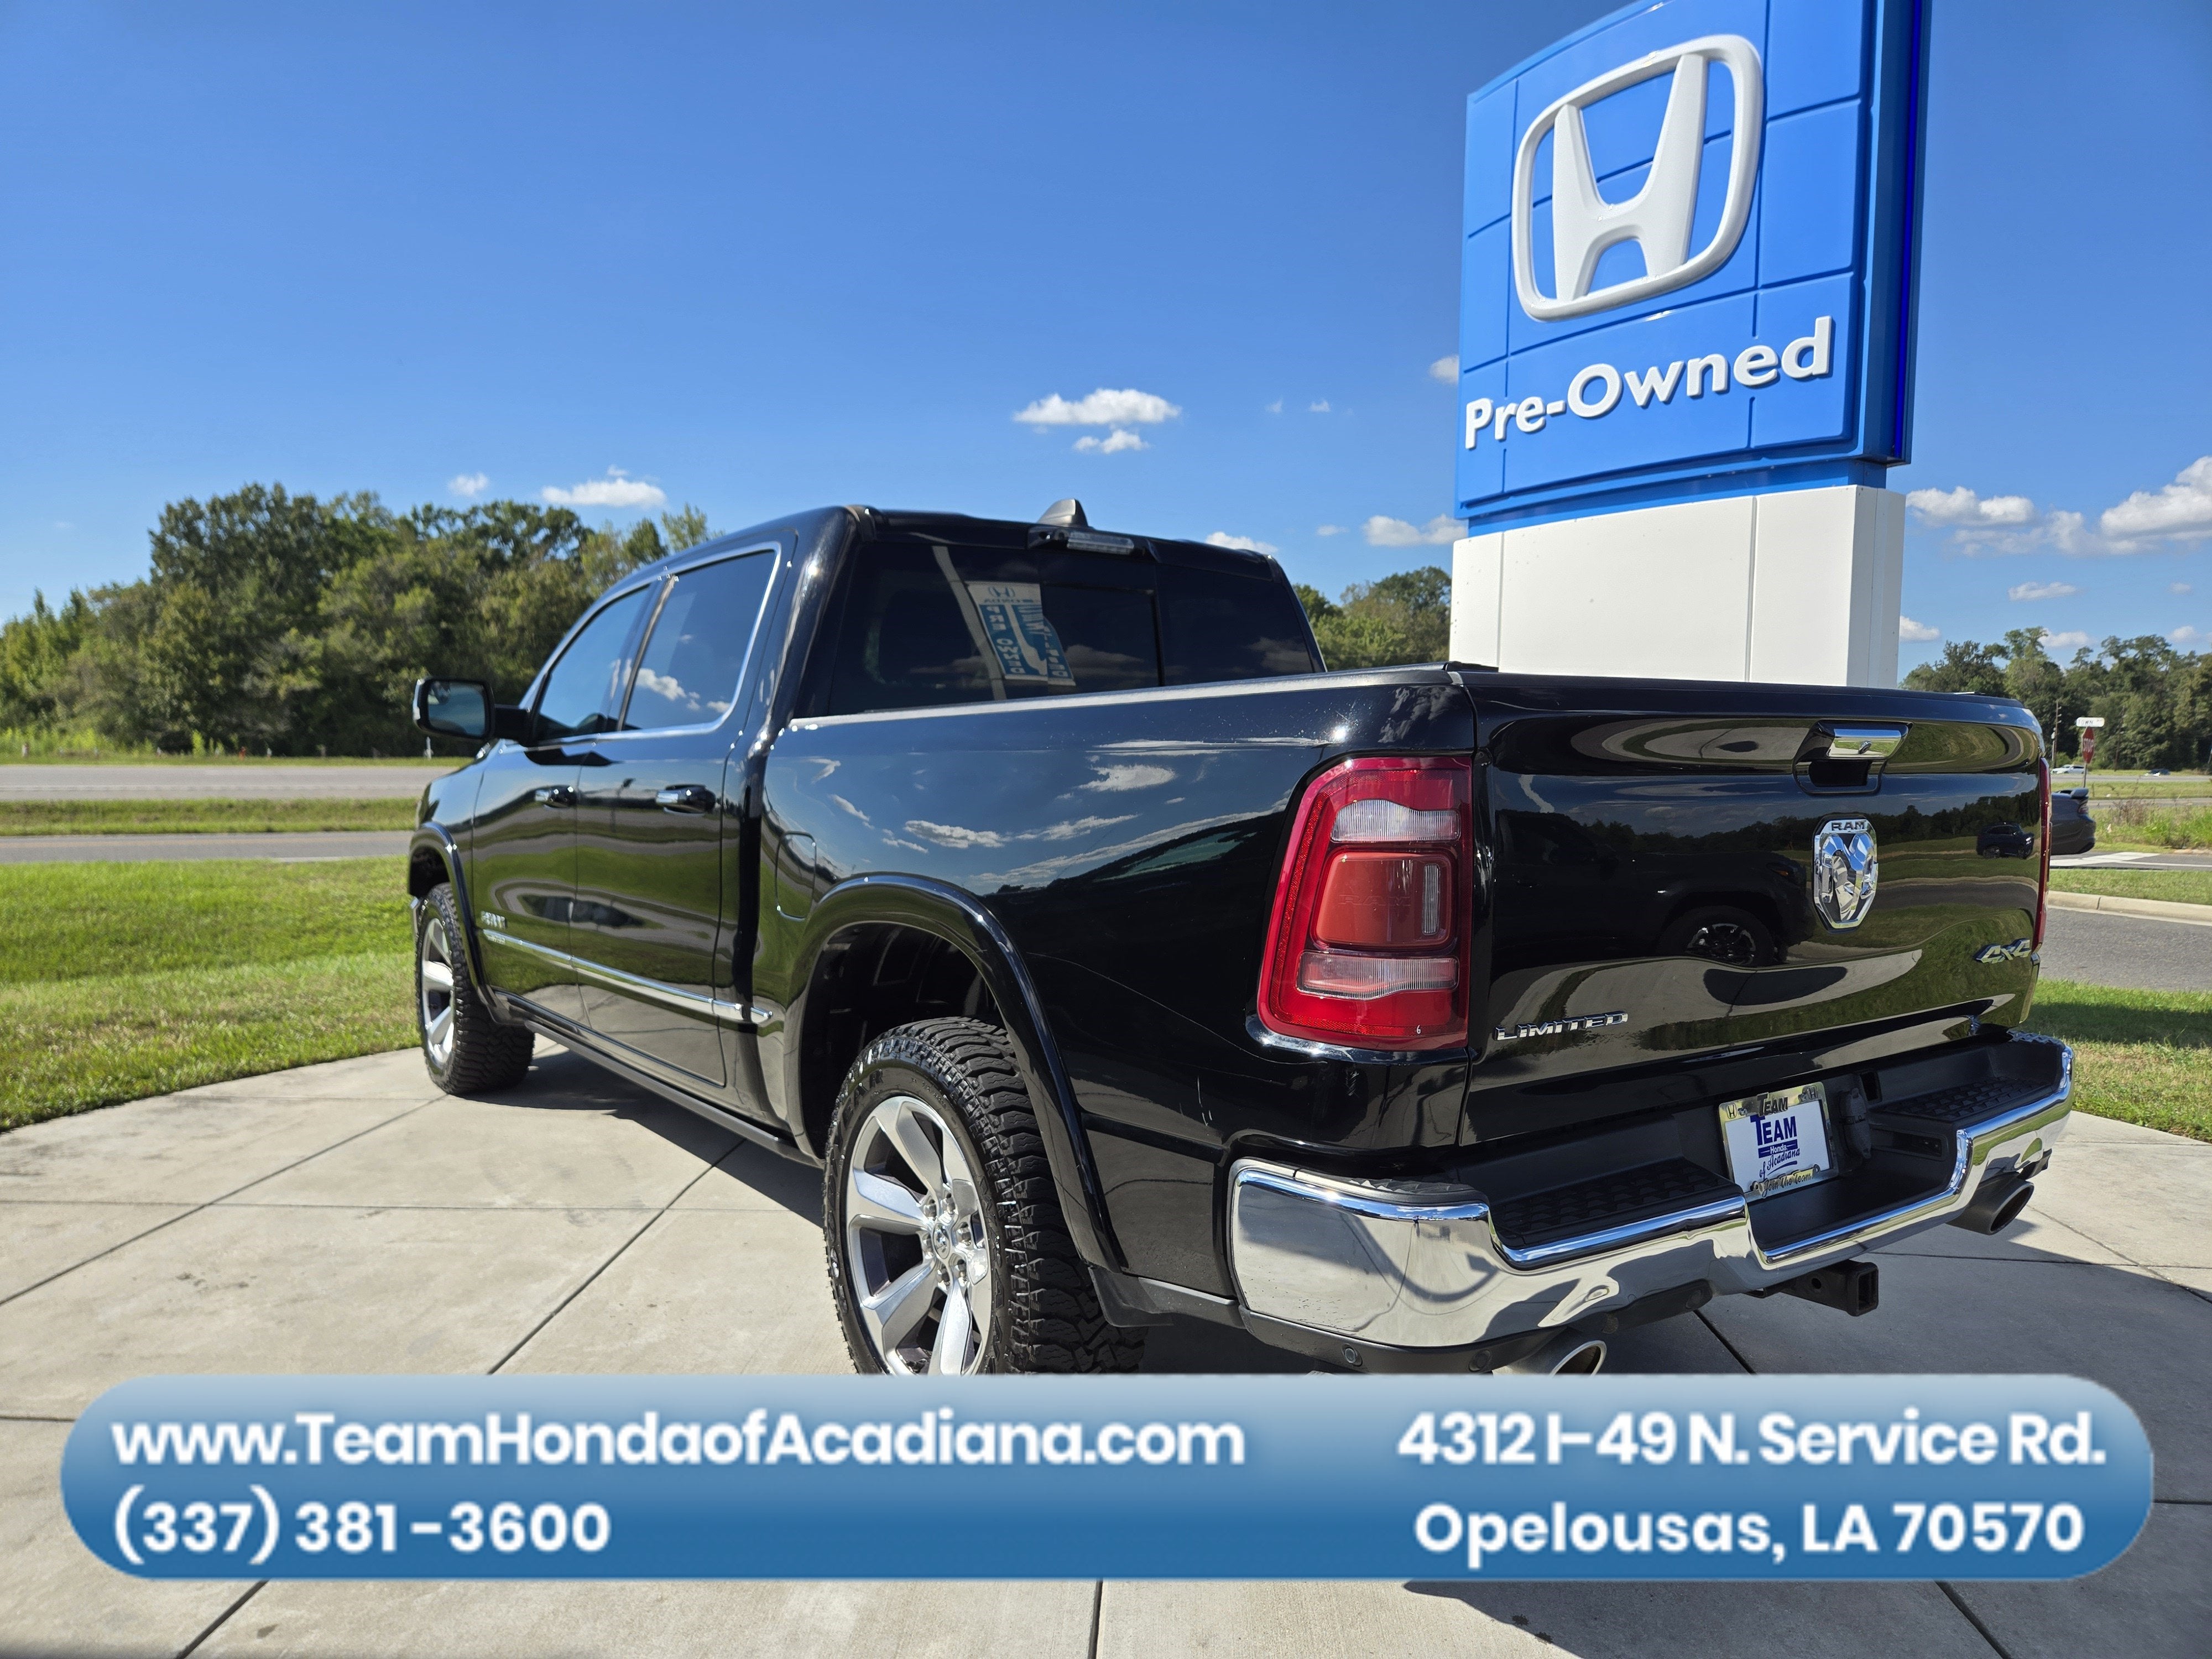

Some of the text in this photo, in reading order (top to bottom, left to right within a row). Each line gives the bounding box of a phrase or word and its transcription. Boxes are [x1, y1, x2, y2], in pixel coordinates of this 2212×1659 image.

[1465, 315, 1833, 450] Pre-Owned
[1830, 821, 1868, 831] RAM
[1492, 1010, 1629, 1041] LIMITED
[1757, 1093, 1788, 1117] TEAM
[1750, 1114, 1797, 1146] TEAM
[1770, 1144, 1787, 1155] Honda
[1759, 1148, 1801, 1180] of Acadiana
[1762, 1178, 1778, 1198] Join
